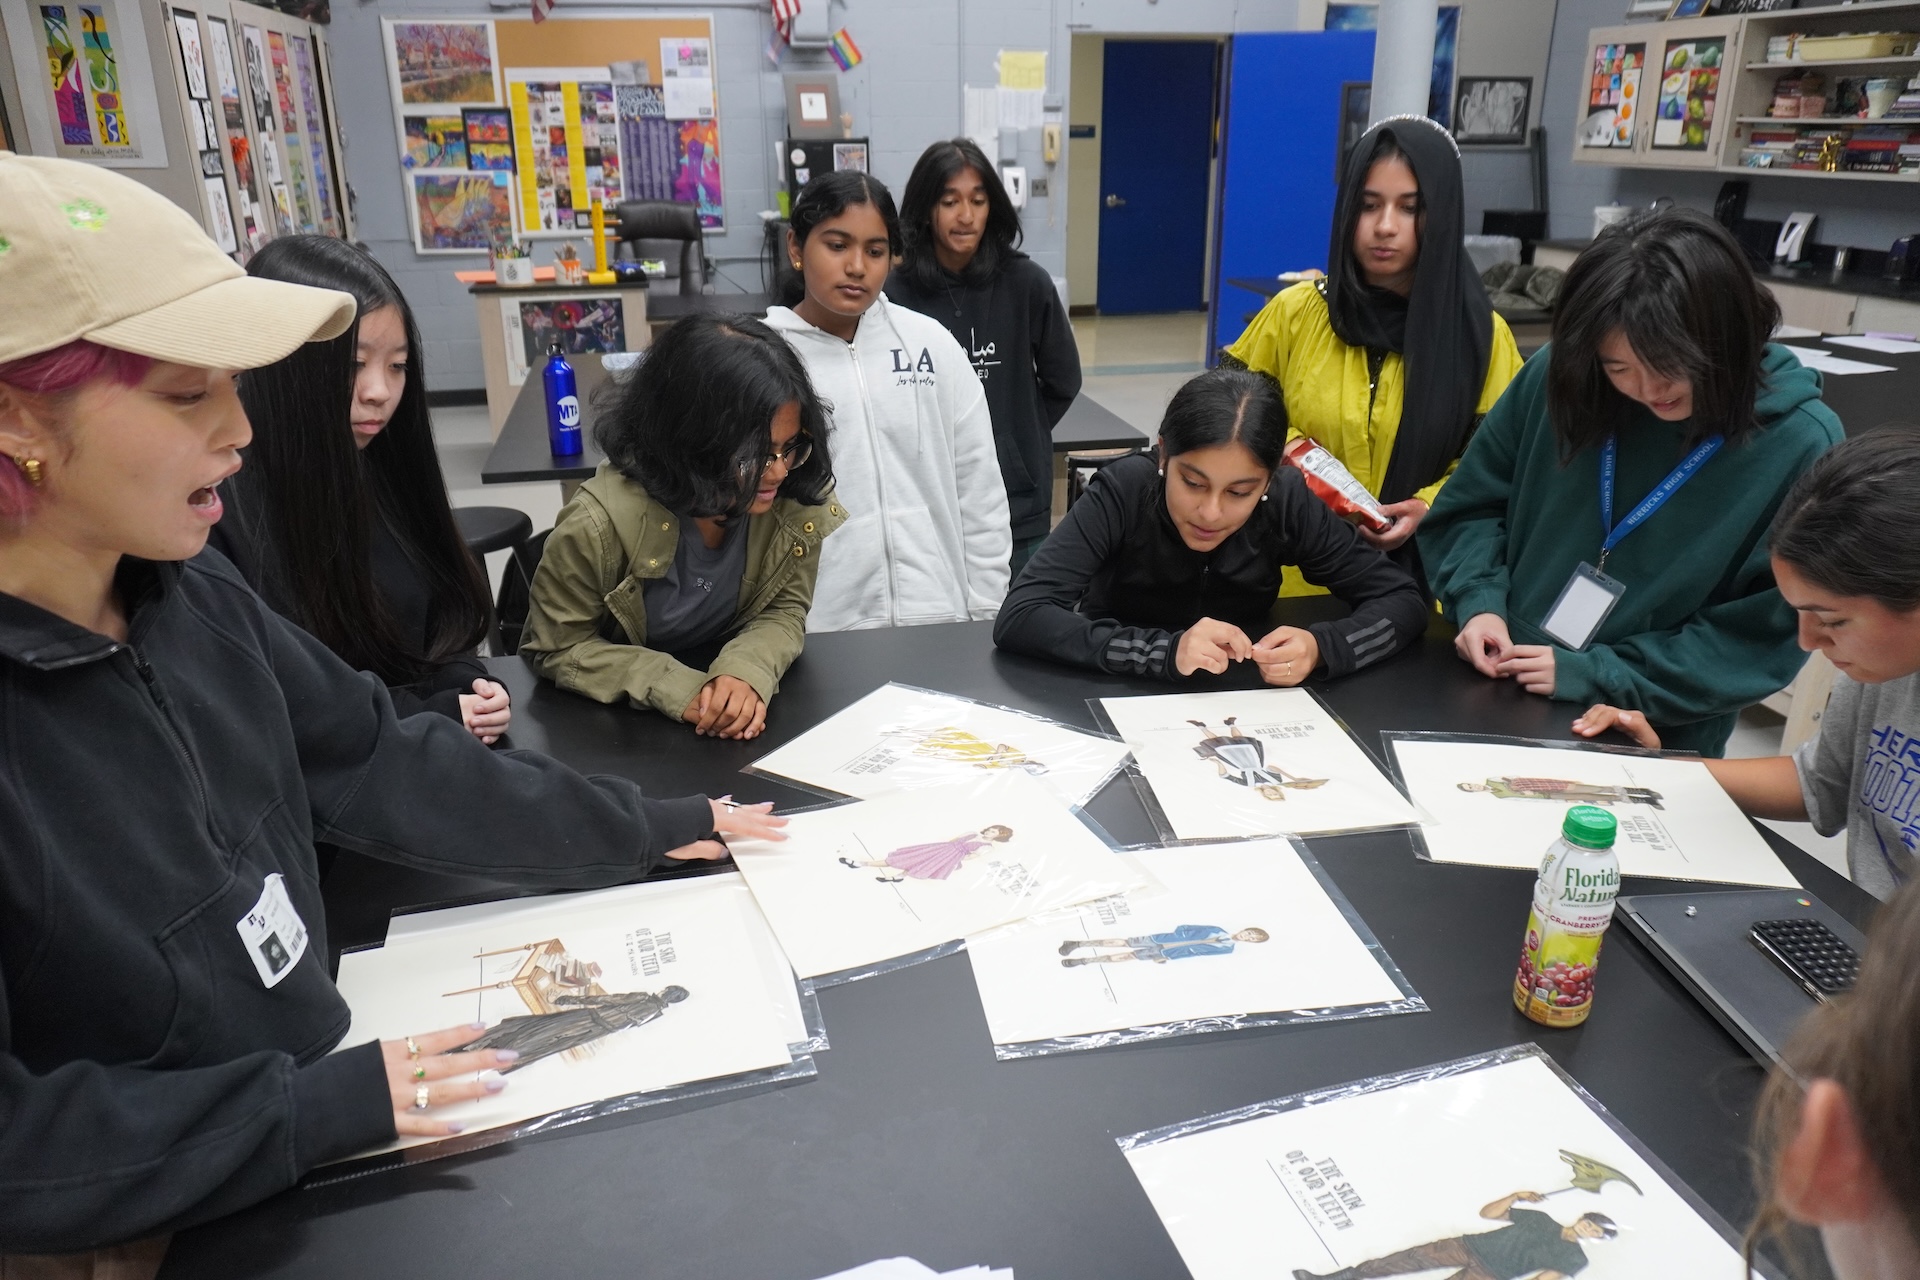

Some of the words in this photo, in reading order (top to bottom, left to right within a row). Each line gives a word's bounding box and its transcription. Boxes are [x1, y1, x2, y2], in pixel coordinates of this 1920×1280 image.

[896, 375, 907, 386] Los
[1604, 454, 1613, 476] HIGH
[1626, 490, 1665, 526] HERRICKS
[1663, 470, 1685, 491] HIGH
[1683, 441, 1716, 472] SCHOOL
[1549, 914, 1600, 930] CRANBERRY
[1578, 914, 1609, 922] PREMIUM
[636, 927, 652, 937] OF
[637, 937, 656, 953] OUR
[640, 952, 660, 977] TEETH
[1285, 1149, 1310, 1165] OF
[1297, 1166, 1326, 1191] OUR
[1314, 1156, 1344, 1181] THE
[1332, 1181, 1366, 1211] SKIN
[1314, 1190, 1355, 1231] TEETH
